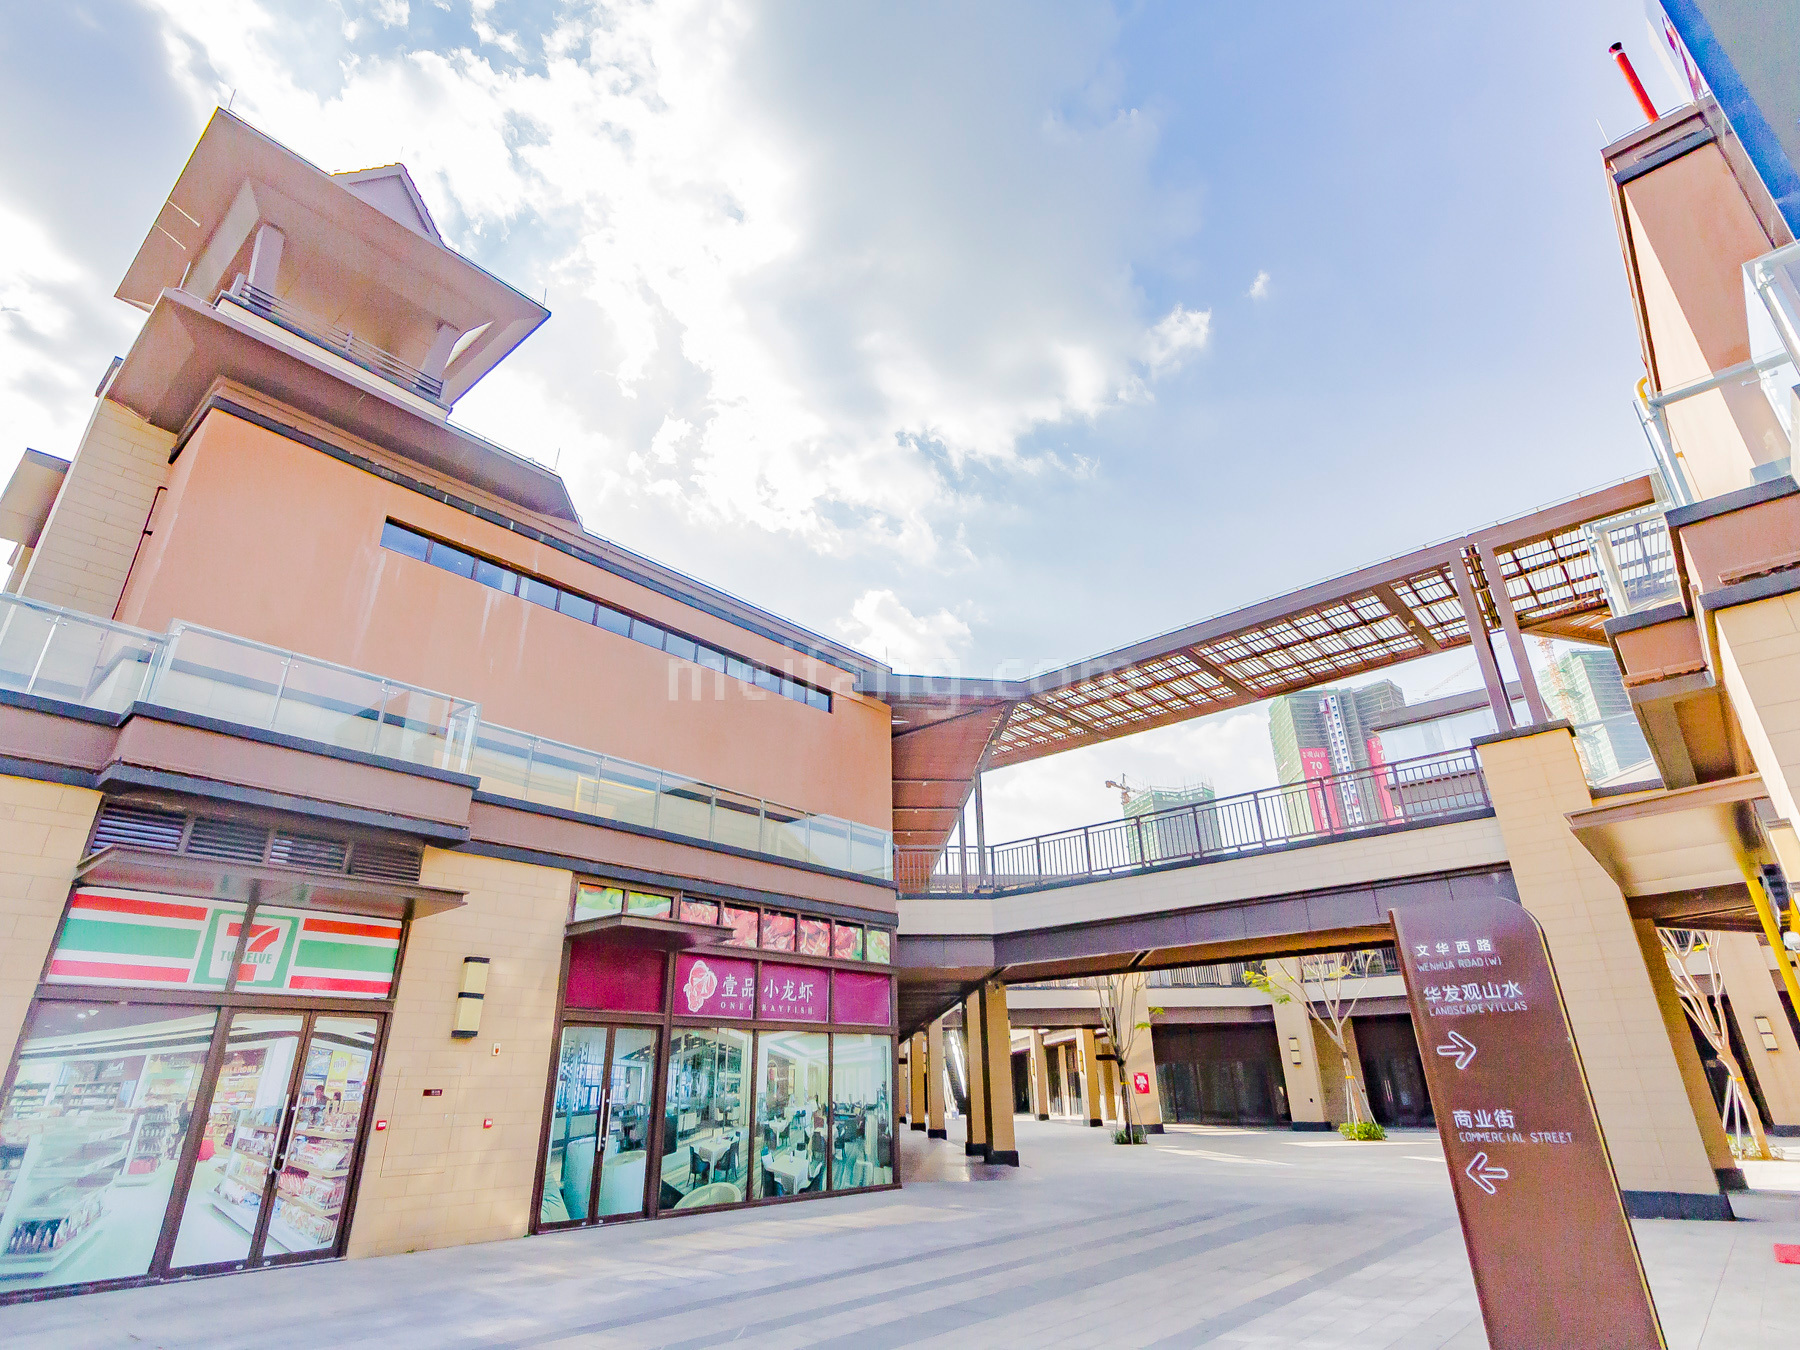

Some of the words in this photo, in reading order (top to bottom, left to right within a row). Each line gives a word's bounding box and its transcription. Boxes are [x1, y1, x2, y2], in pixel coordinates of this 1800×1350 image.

[1310, 761, 1323, 770] 70
[1416, 939, 1491, 957] 文华西路
[1417, 960, 1455, 972] WENHUA
[1423, 980, 1523, 1004] 华发观山水
[1428, 1002, 1485, 1017] LANDSCAPE
[1486, 1000, 1528, 1013] VILLAS
[1452, 1109, 1515, 1129] 商业街
[1459, 1131, 1526, 1143] COMMERCIAL
[1530, 1132, 1573, 1143] STREET
